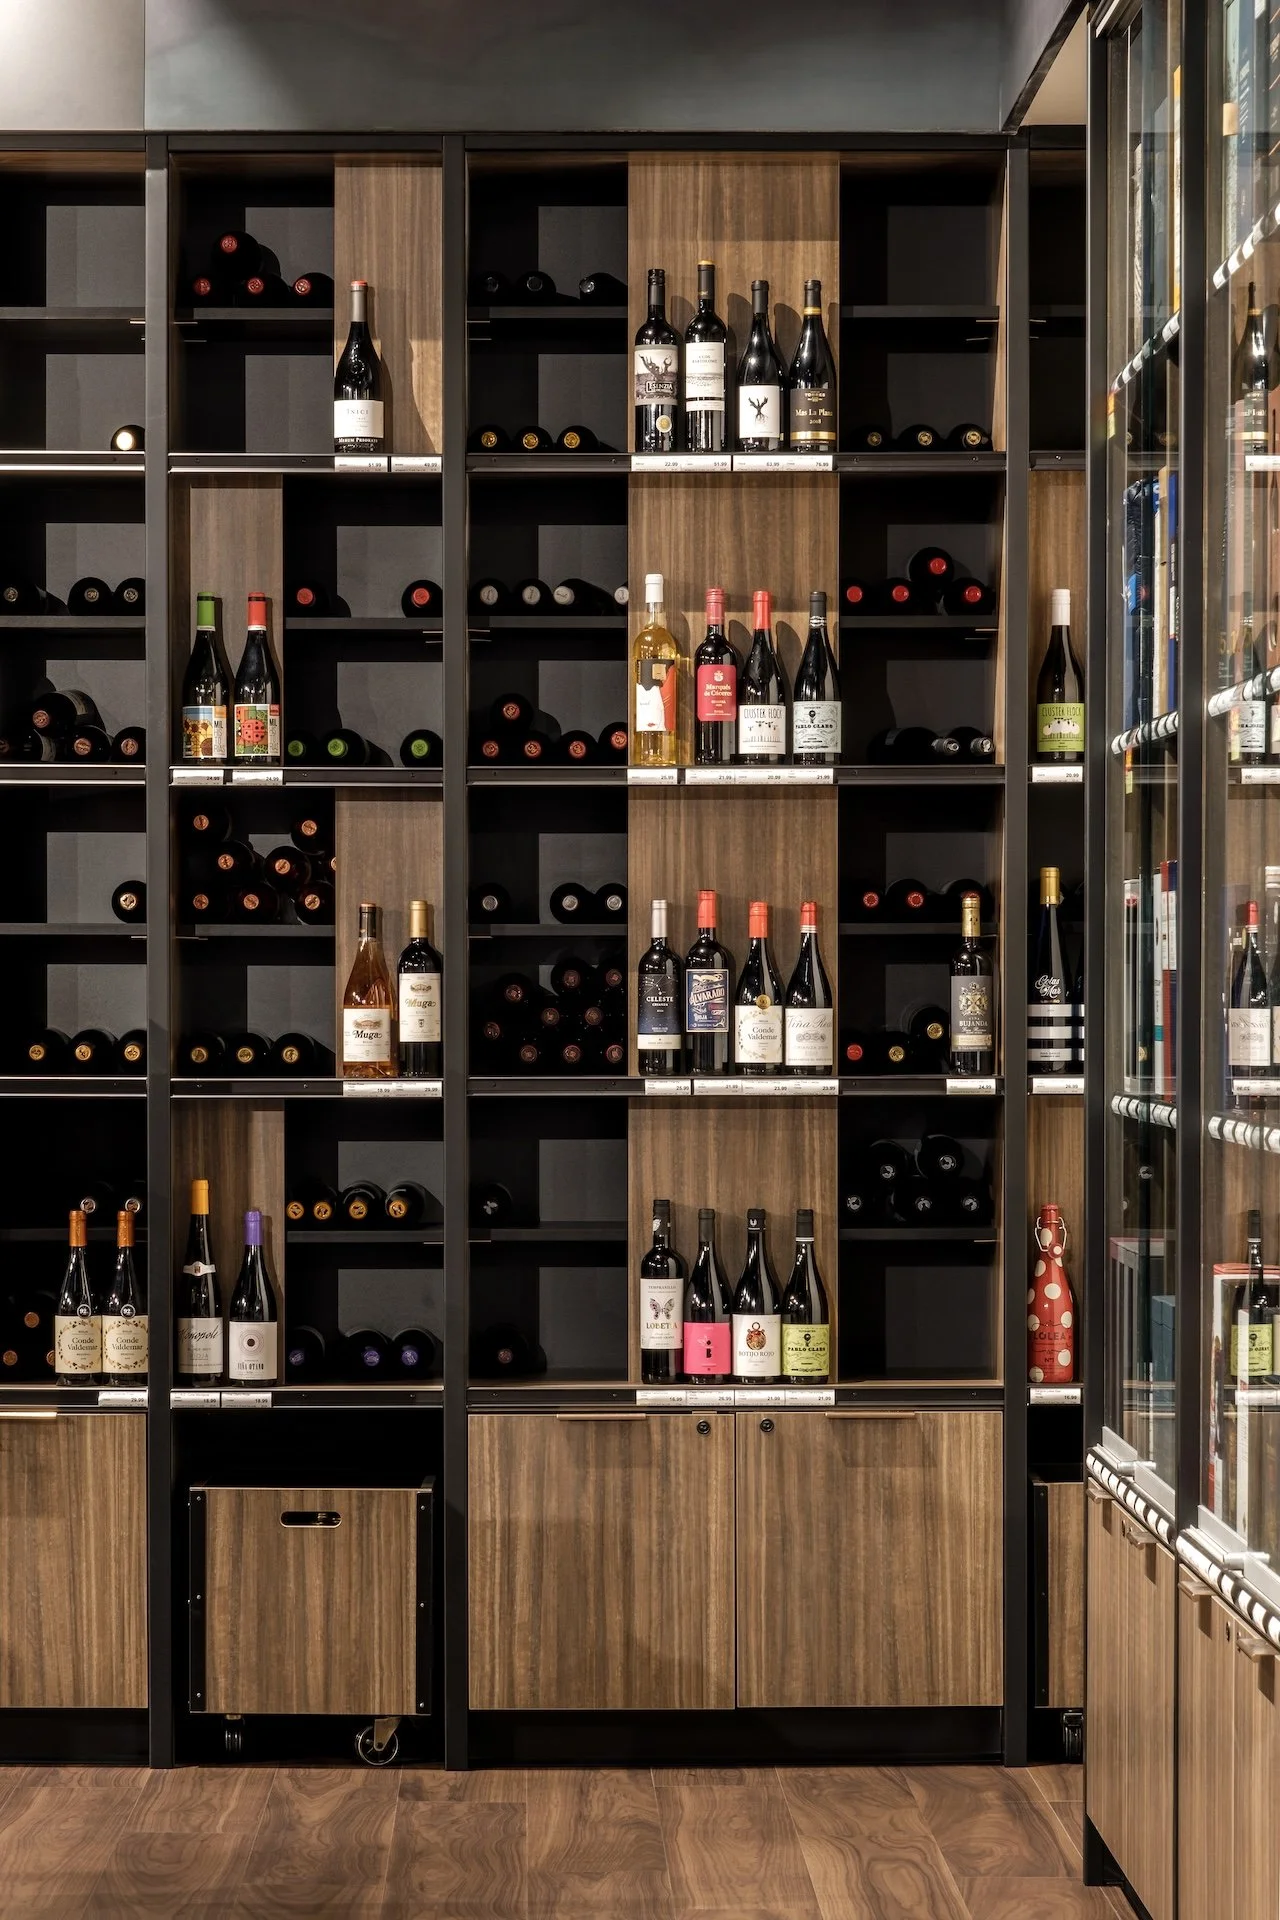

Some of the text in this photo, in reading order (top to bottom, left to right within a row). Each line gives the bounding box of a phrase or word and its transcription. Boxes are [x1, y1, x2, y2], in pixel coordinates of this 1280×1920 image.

[744, 708, 766, 719] CLUSTER
[690, 987, 725, 1005] ALVARADO
[405, 999, 436, 1008] Muga
[752, 1026, 775, 1034] Conde
[352, 1030, 382, 1040] Muga
[1034, 1332, 1066, 1340] LOLEA
